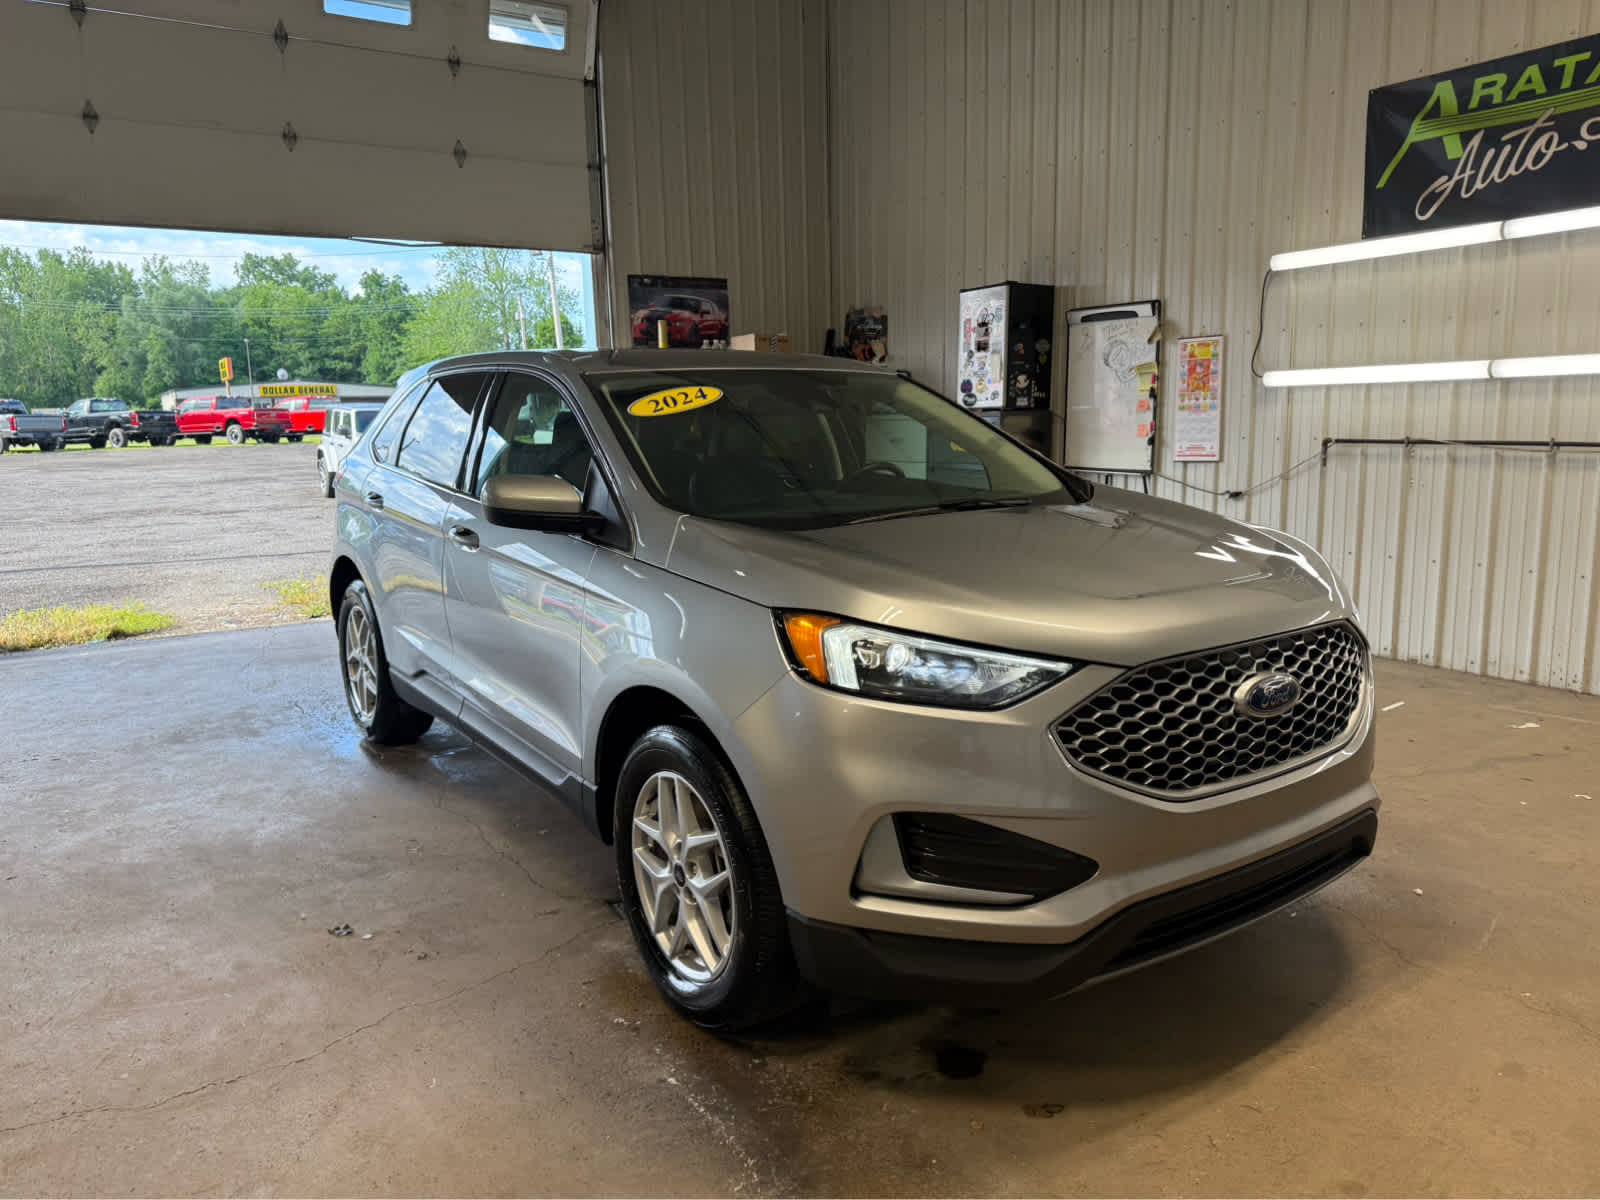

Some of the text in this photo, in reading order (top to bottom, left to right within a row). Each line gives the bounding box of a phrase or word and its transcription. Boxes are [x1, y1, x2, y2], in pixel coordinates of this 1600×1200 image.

[1415, 107, 1568, 221] Auto
[263, 385, 335, 395] DOLLAR GENERAL
[648, 388, 708, 413] 2024
